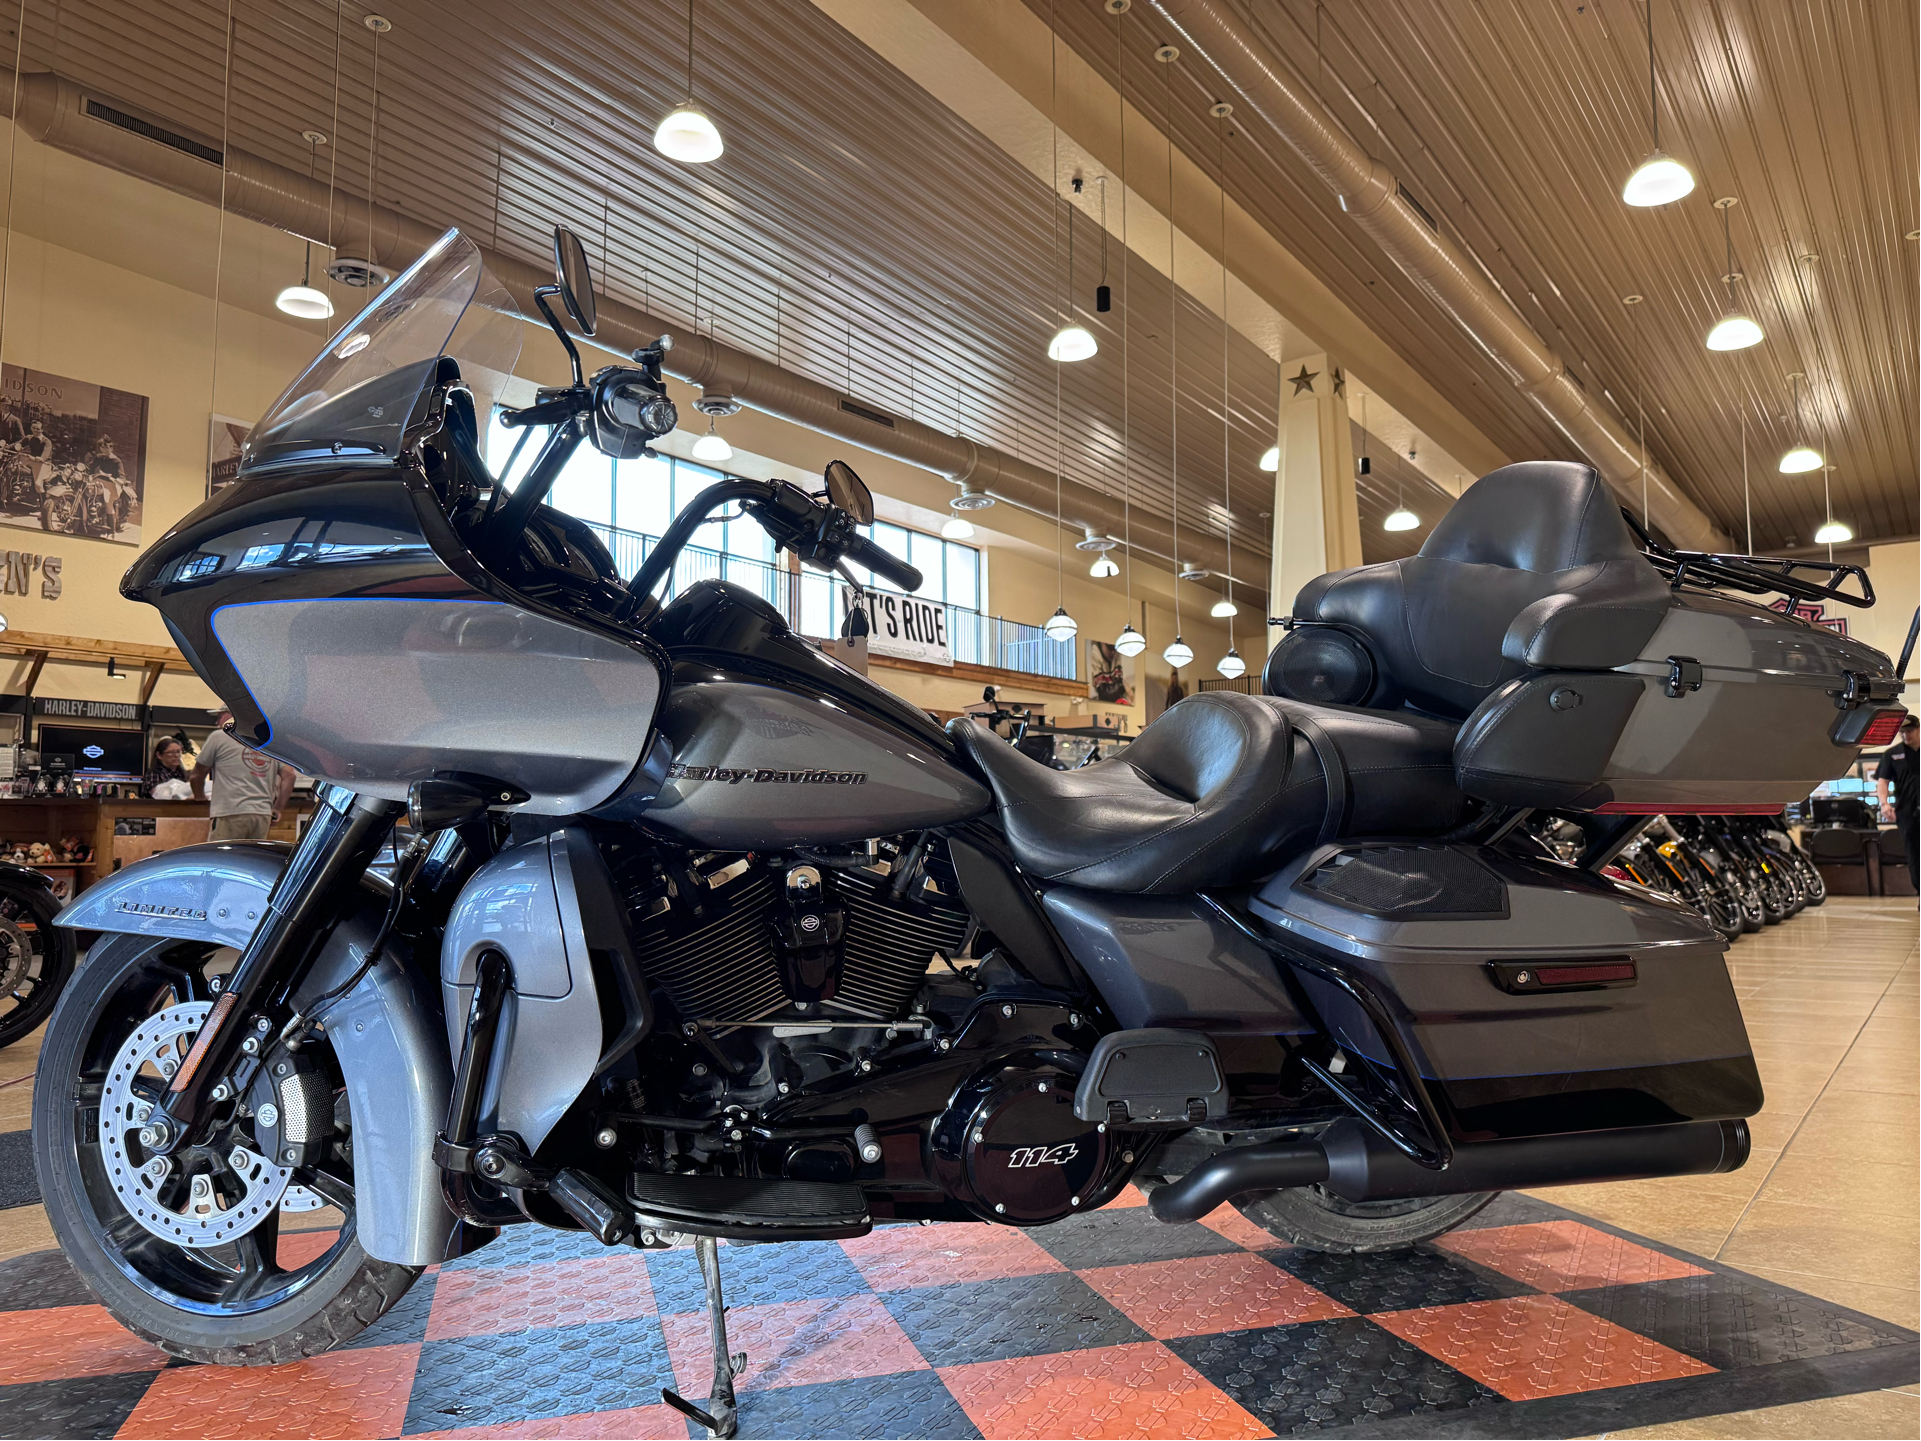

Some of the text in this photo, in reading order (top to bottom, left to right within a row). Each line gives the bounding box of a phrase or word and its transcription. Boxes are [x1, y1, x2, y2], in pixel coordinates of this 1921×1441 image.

[2, 376, 63, 400] IDSON
[0, 549, 62, 601] N'S
[902, 600, 946, 647] RIDE
[44, 699, 136, 719] HARLEY-DAVIDSON
[666, 763, 868, 785] Harley-Davidson
[118, 902, 208, 920] LIMITED
[1008, 1143, 1079, 1168] 114
